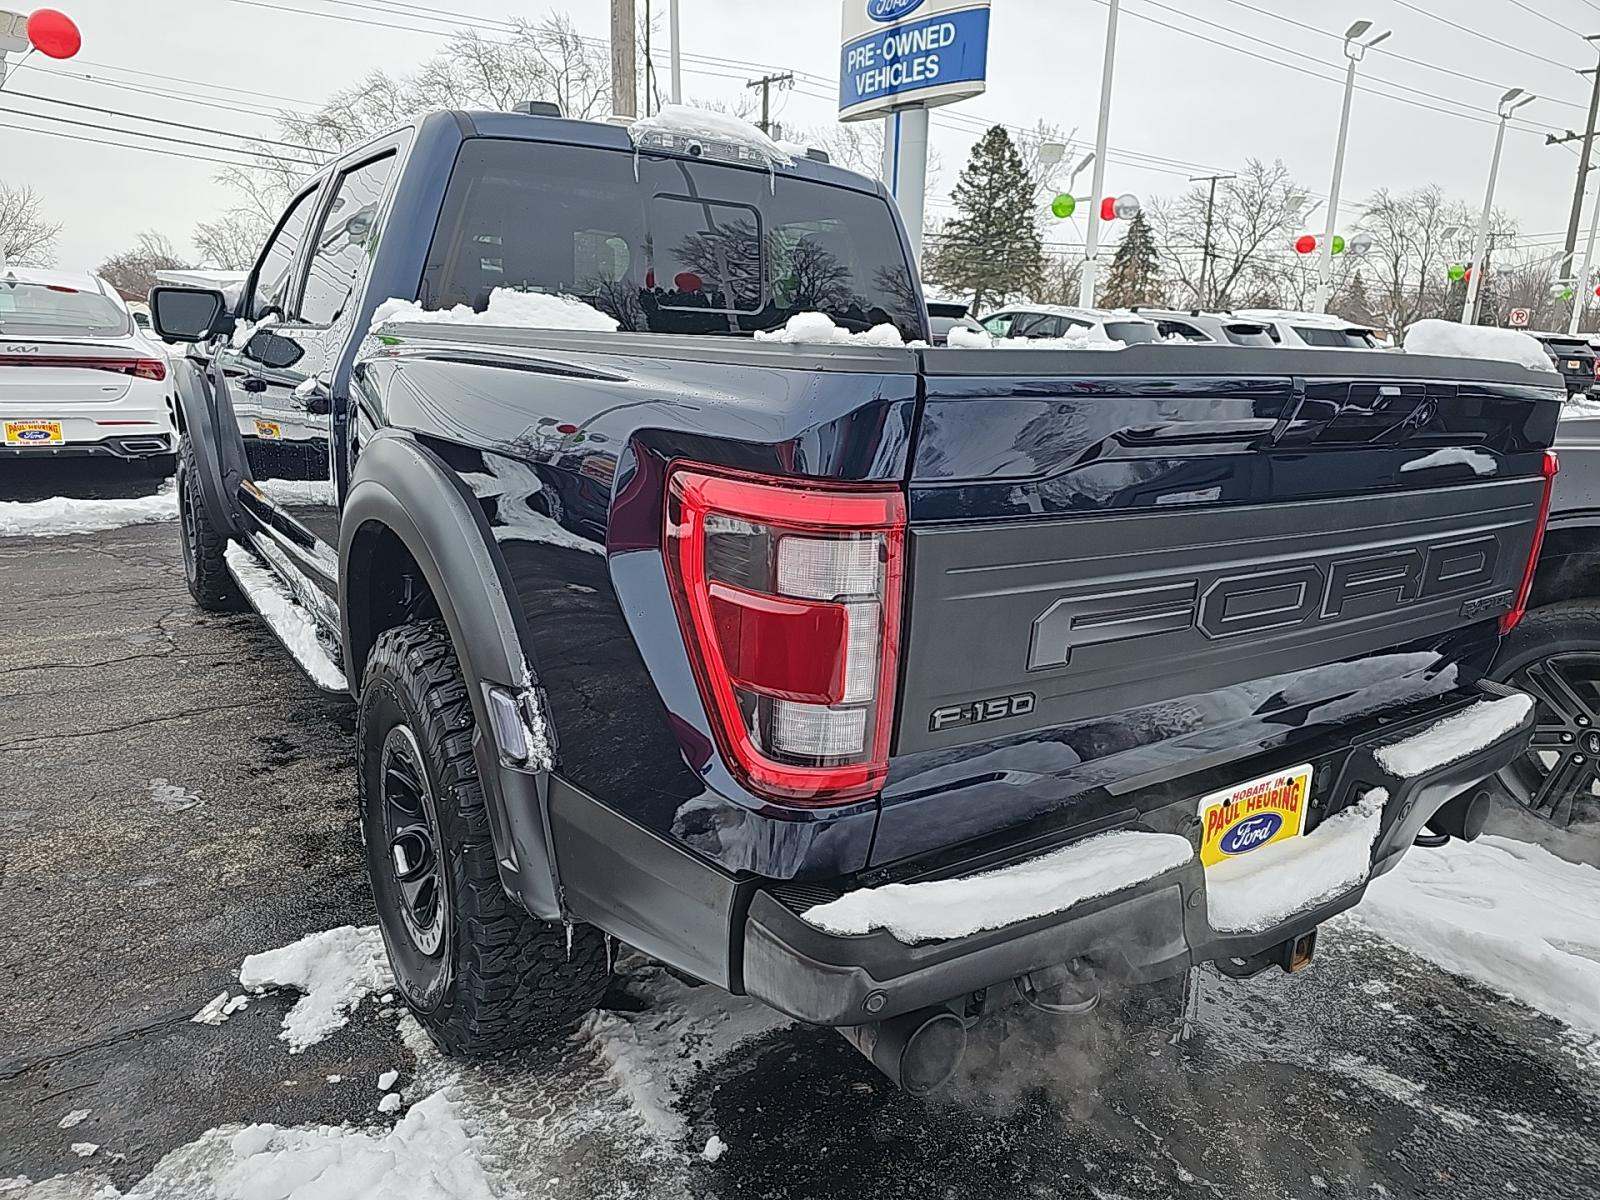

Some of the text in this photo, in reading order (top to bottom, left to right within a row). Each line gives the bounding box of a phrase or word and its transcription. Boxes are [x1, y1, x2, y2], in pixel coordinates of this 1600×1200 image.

[848, 22, 956, 73] PRE-OWNED
[856, 55, 940, 96] VEHICLES
[24, 431, 46, 439] Ford
[1025, 534, 1501, 672] FORD
[930, 693, 1036, 731] F-150
[1206, 782, 1300, 844] PAUL HEURING
[1231, 818, 1273, 850] Ford
